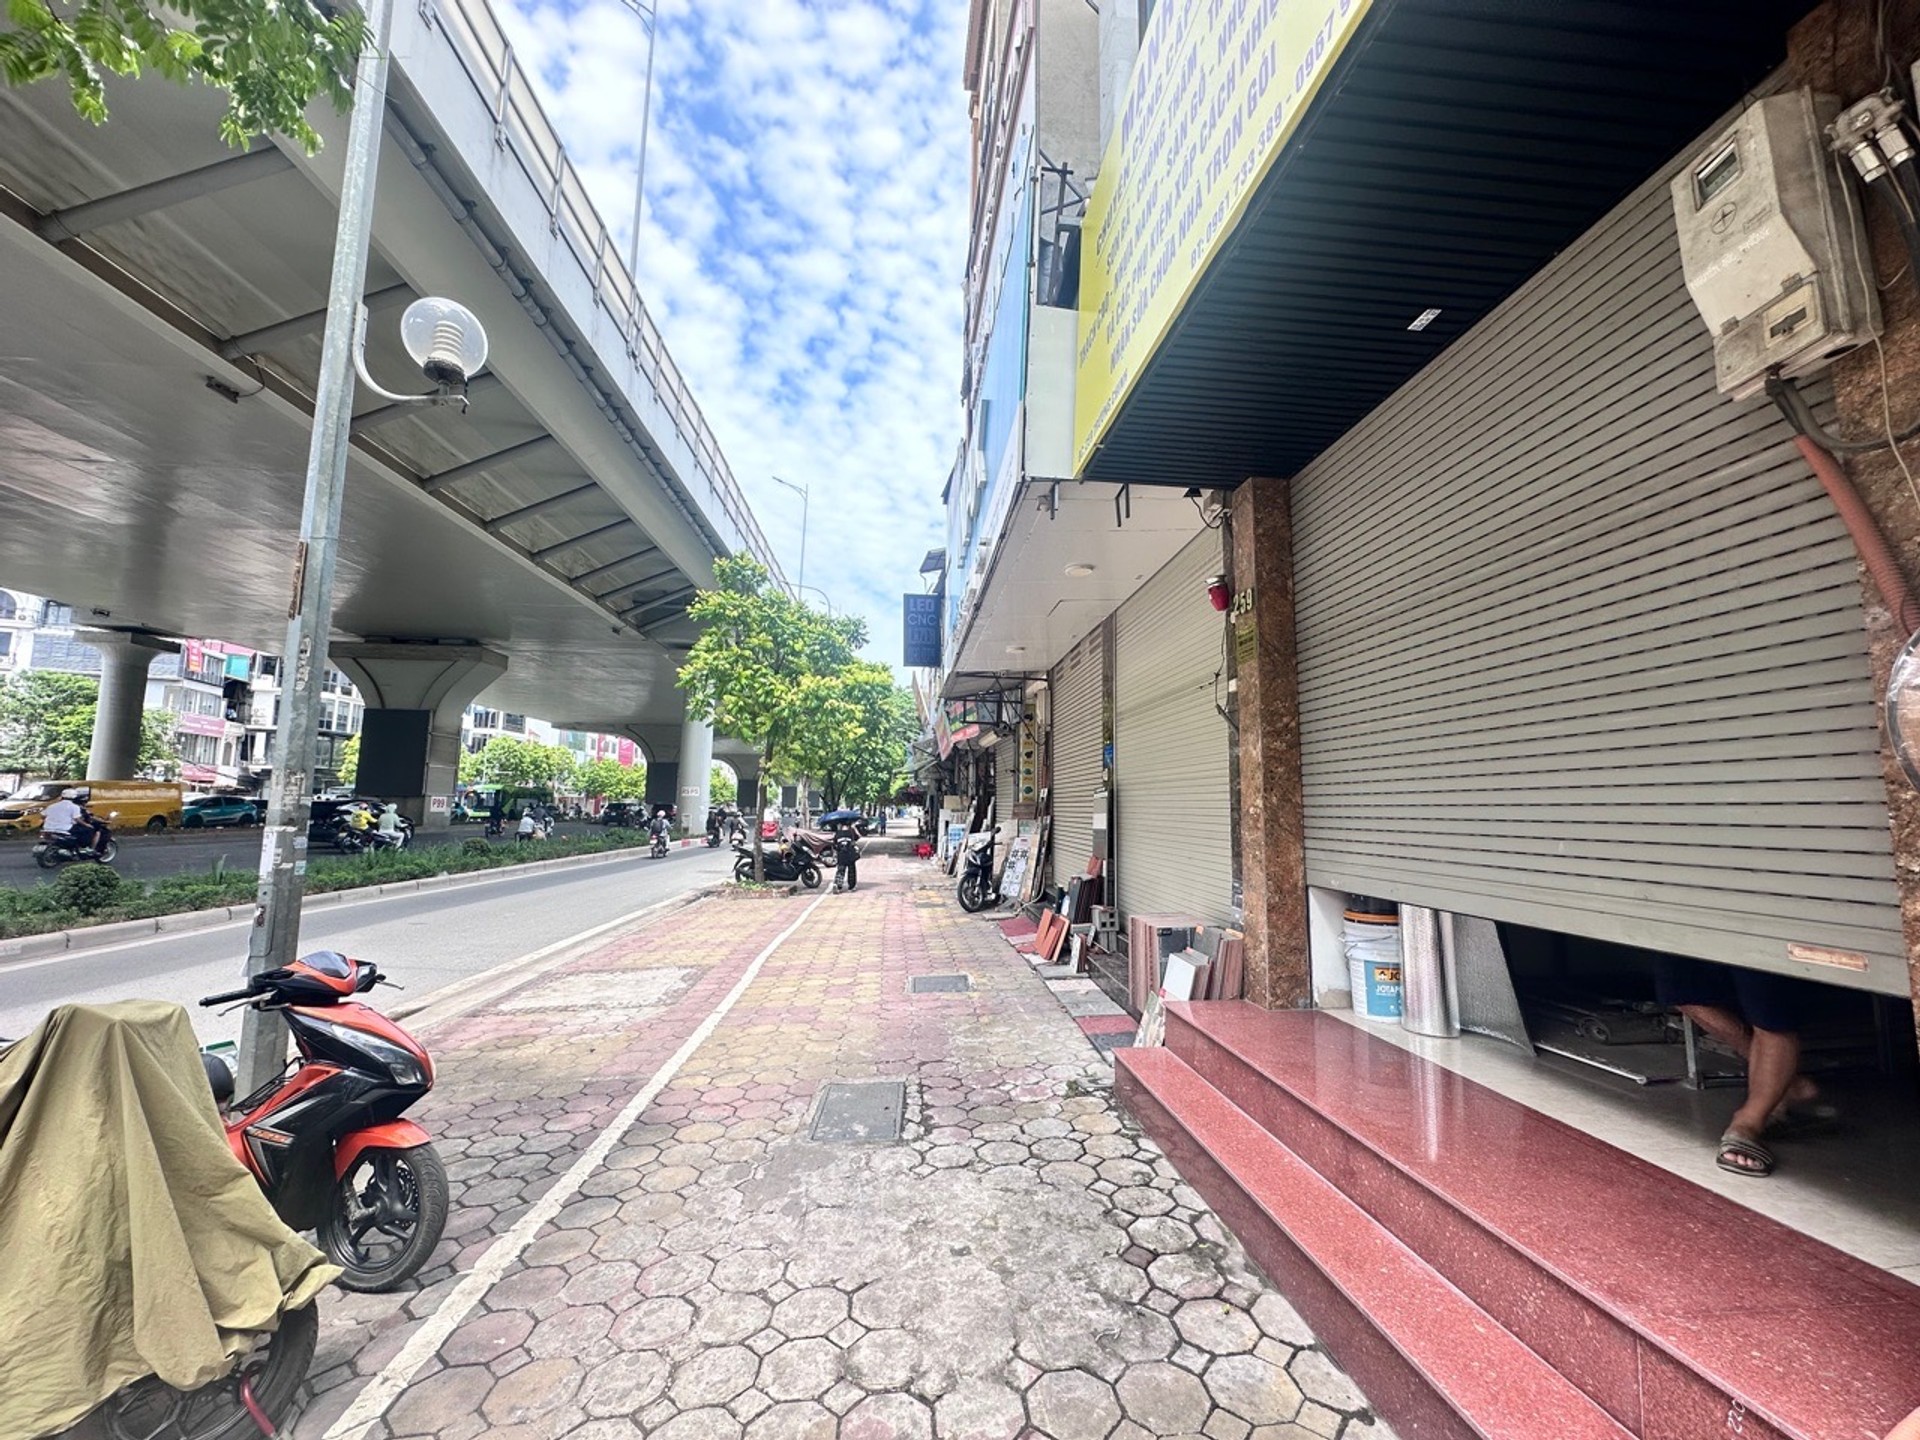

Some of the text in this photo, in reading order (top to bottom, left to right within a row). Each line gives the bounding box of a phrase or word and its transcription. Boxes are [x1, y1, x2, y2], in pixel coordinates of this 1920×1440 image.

[1200, 59, 1235, 155] CÁCH
[1233, 155, 1255, 197] 733
[1257, 102, 1282, 157] 389
[1295, 8, 1335, 93] 0967
[1179, 178, 1203, 247] NHÀ
[1205, 103, 1243, 202] TRỌN
[1247, 40, 1276, 120] GÓI
[907, 613, 937, 626] CNC
[909, 598, 935, 612] LED
[1232, 588, 1252, 614] 259
